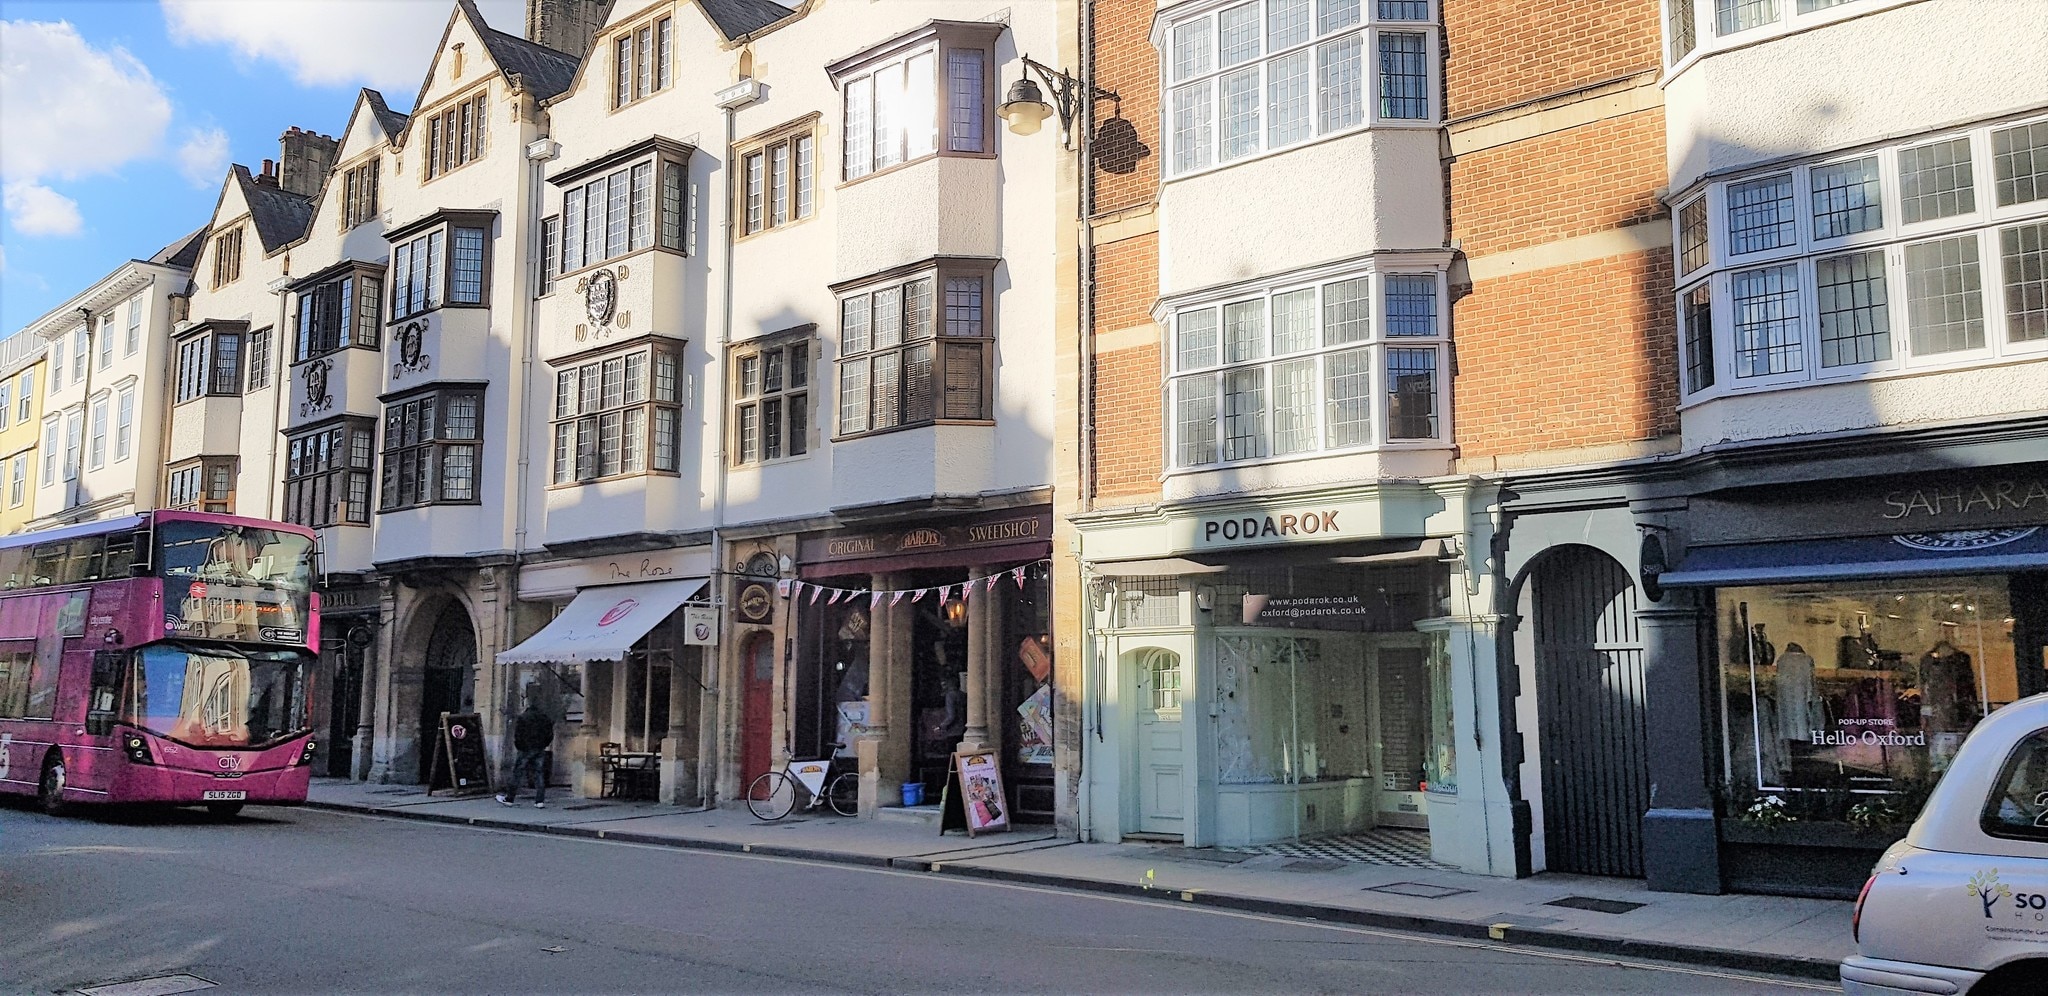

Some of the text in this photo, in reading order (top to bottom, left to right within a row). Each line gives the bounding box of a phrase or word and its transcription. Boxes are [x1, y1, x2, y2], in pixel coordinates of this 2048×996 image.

[1883, 480, 2048, 519] SAHARA
[969, 519, 1039, 542] SWEETSHOP
[1205, 510, 1340, 541] PODAROK
[829, 538, 875, 556] ORIGINAL
[610, 558, 672, 579] The Rose
[1269, 595, 1359, 606] www.podarok.co.uk
[1262, 606, 1366, 617] oxford@podarok.co.uk
[1838, 718, 1894, 726] POP-UP STORE
[1811, 729, 1926, 746] Hello Oxford
[218, 754, 242, 771] city
[208, 791, 225, 799] SL15
[2015, 893, 2047, 910] SO
